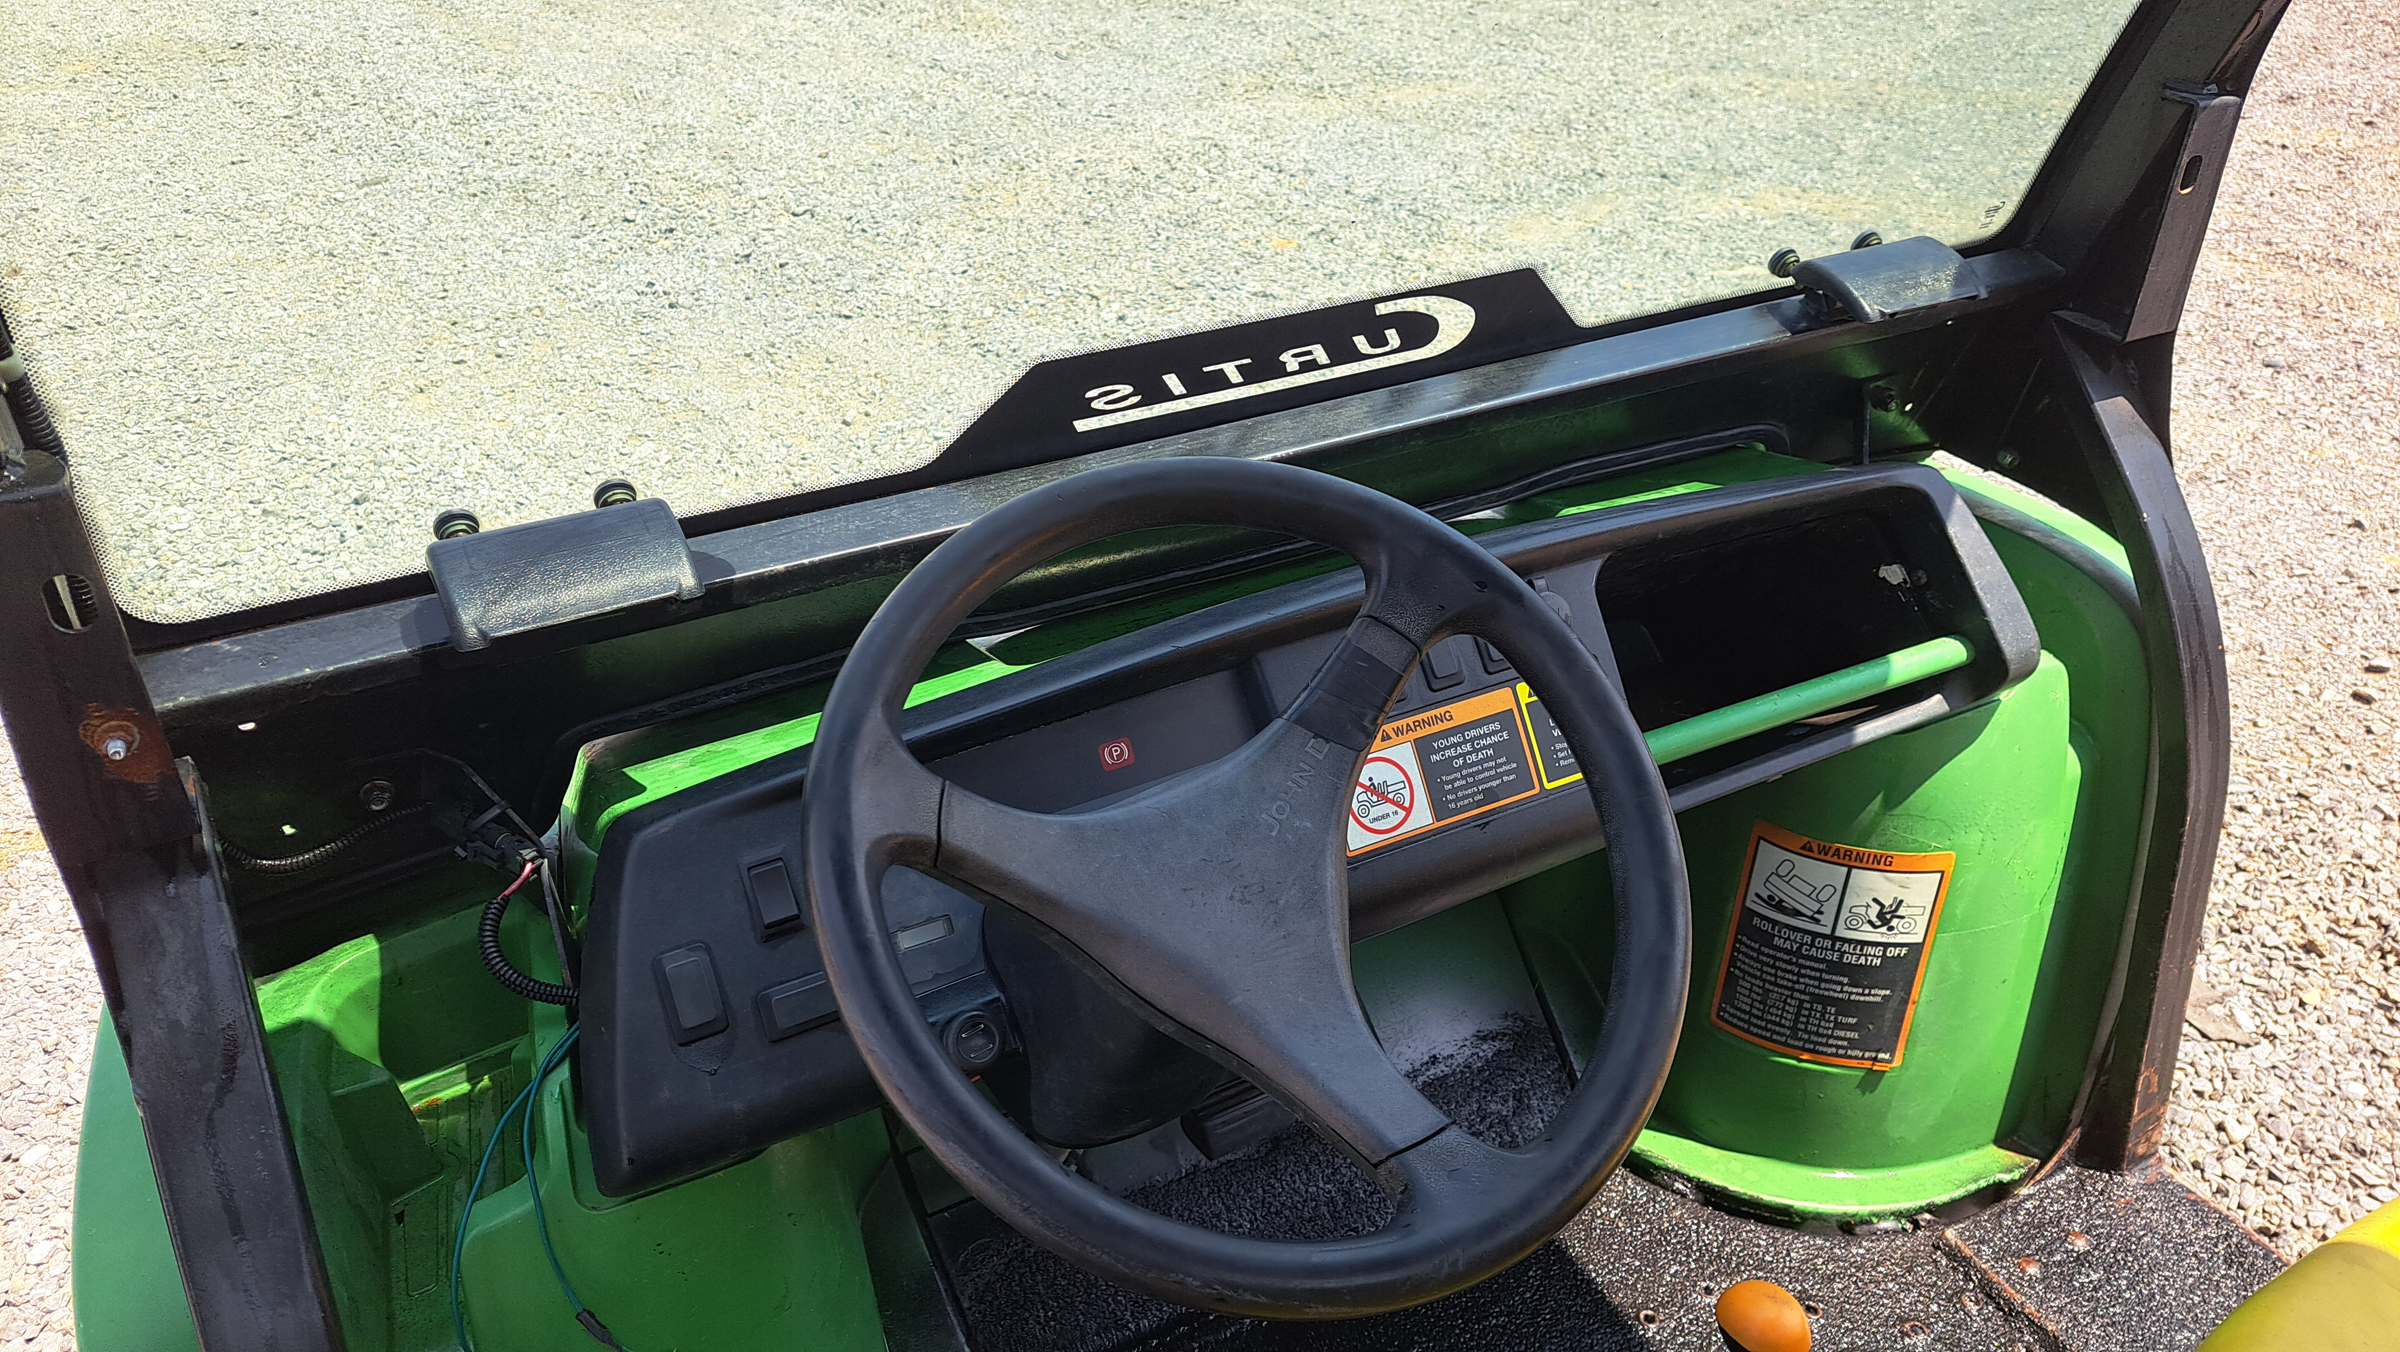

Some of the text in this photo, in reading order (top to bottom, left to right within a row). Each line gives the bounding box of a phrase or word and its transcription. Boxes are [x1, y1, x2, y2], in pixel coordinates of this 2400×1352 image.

[1391, 710, 1454, 738] WARNING
[1432, 722, 1501, 749] YOUNG DRIVERS
[1430, 731, 1510, 763] INCREASE CHANCE
[1453, 748, 1494, 767] OF DEATH
[1441, 756, 1507, 782] Young drivers may not
[1454, 778, 1466, 788] able
[1475, 768, 1496, 780] control
[1496, 762, 1517, 773] vehicle
[1262, 761, 1317, 836] JOHN
[1447, 773, 1517, 801] No drivers younger than
[1456, 797, 1473, 808] years
[1474, 792, 1484, 801] old
[1369, 809, 1399, 824] UNDER 16
[1817, 843, 1895, 867] WARNING
[1752, 917, 1909, 958] ROLLOVER OR FALLING OFF
[1773, 936, 1882, 967] MAY CAUSE DEATH
[1740, 945, 1758, 958] Drive
[1759, 954, 1774, 965] very
[1800, 968, 1820, 978] when
[1821, 972, 1851, 984] turning.
[1798, 958, 1828, 971] manual.
[1777, 970, 1798, 981] brake
[1799, 977, 1819, 987] when
[1820, 982, 1841, 992] going
[1843, 985, 1863, 994] down
[1826, 1006, 1837, 1014] TE
[1837, 1015, 1859, 1024] TURF
[1827, 1038, 1850, 1047] down.
[1833, 1029, 1860, 1039] DIESEL
[1815, 1044, 1837, 1054] rough
